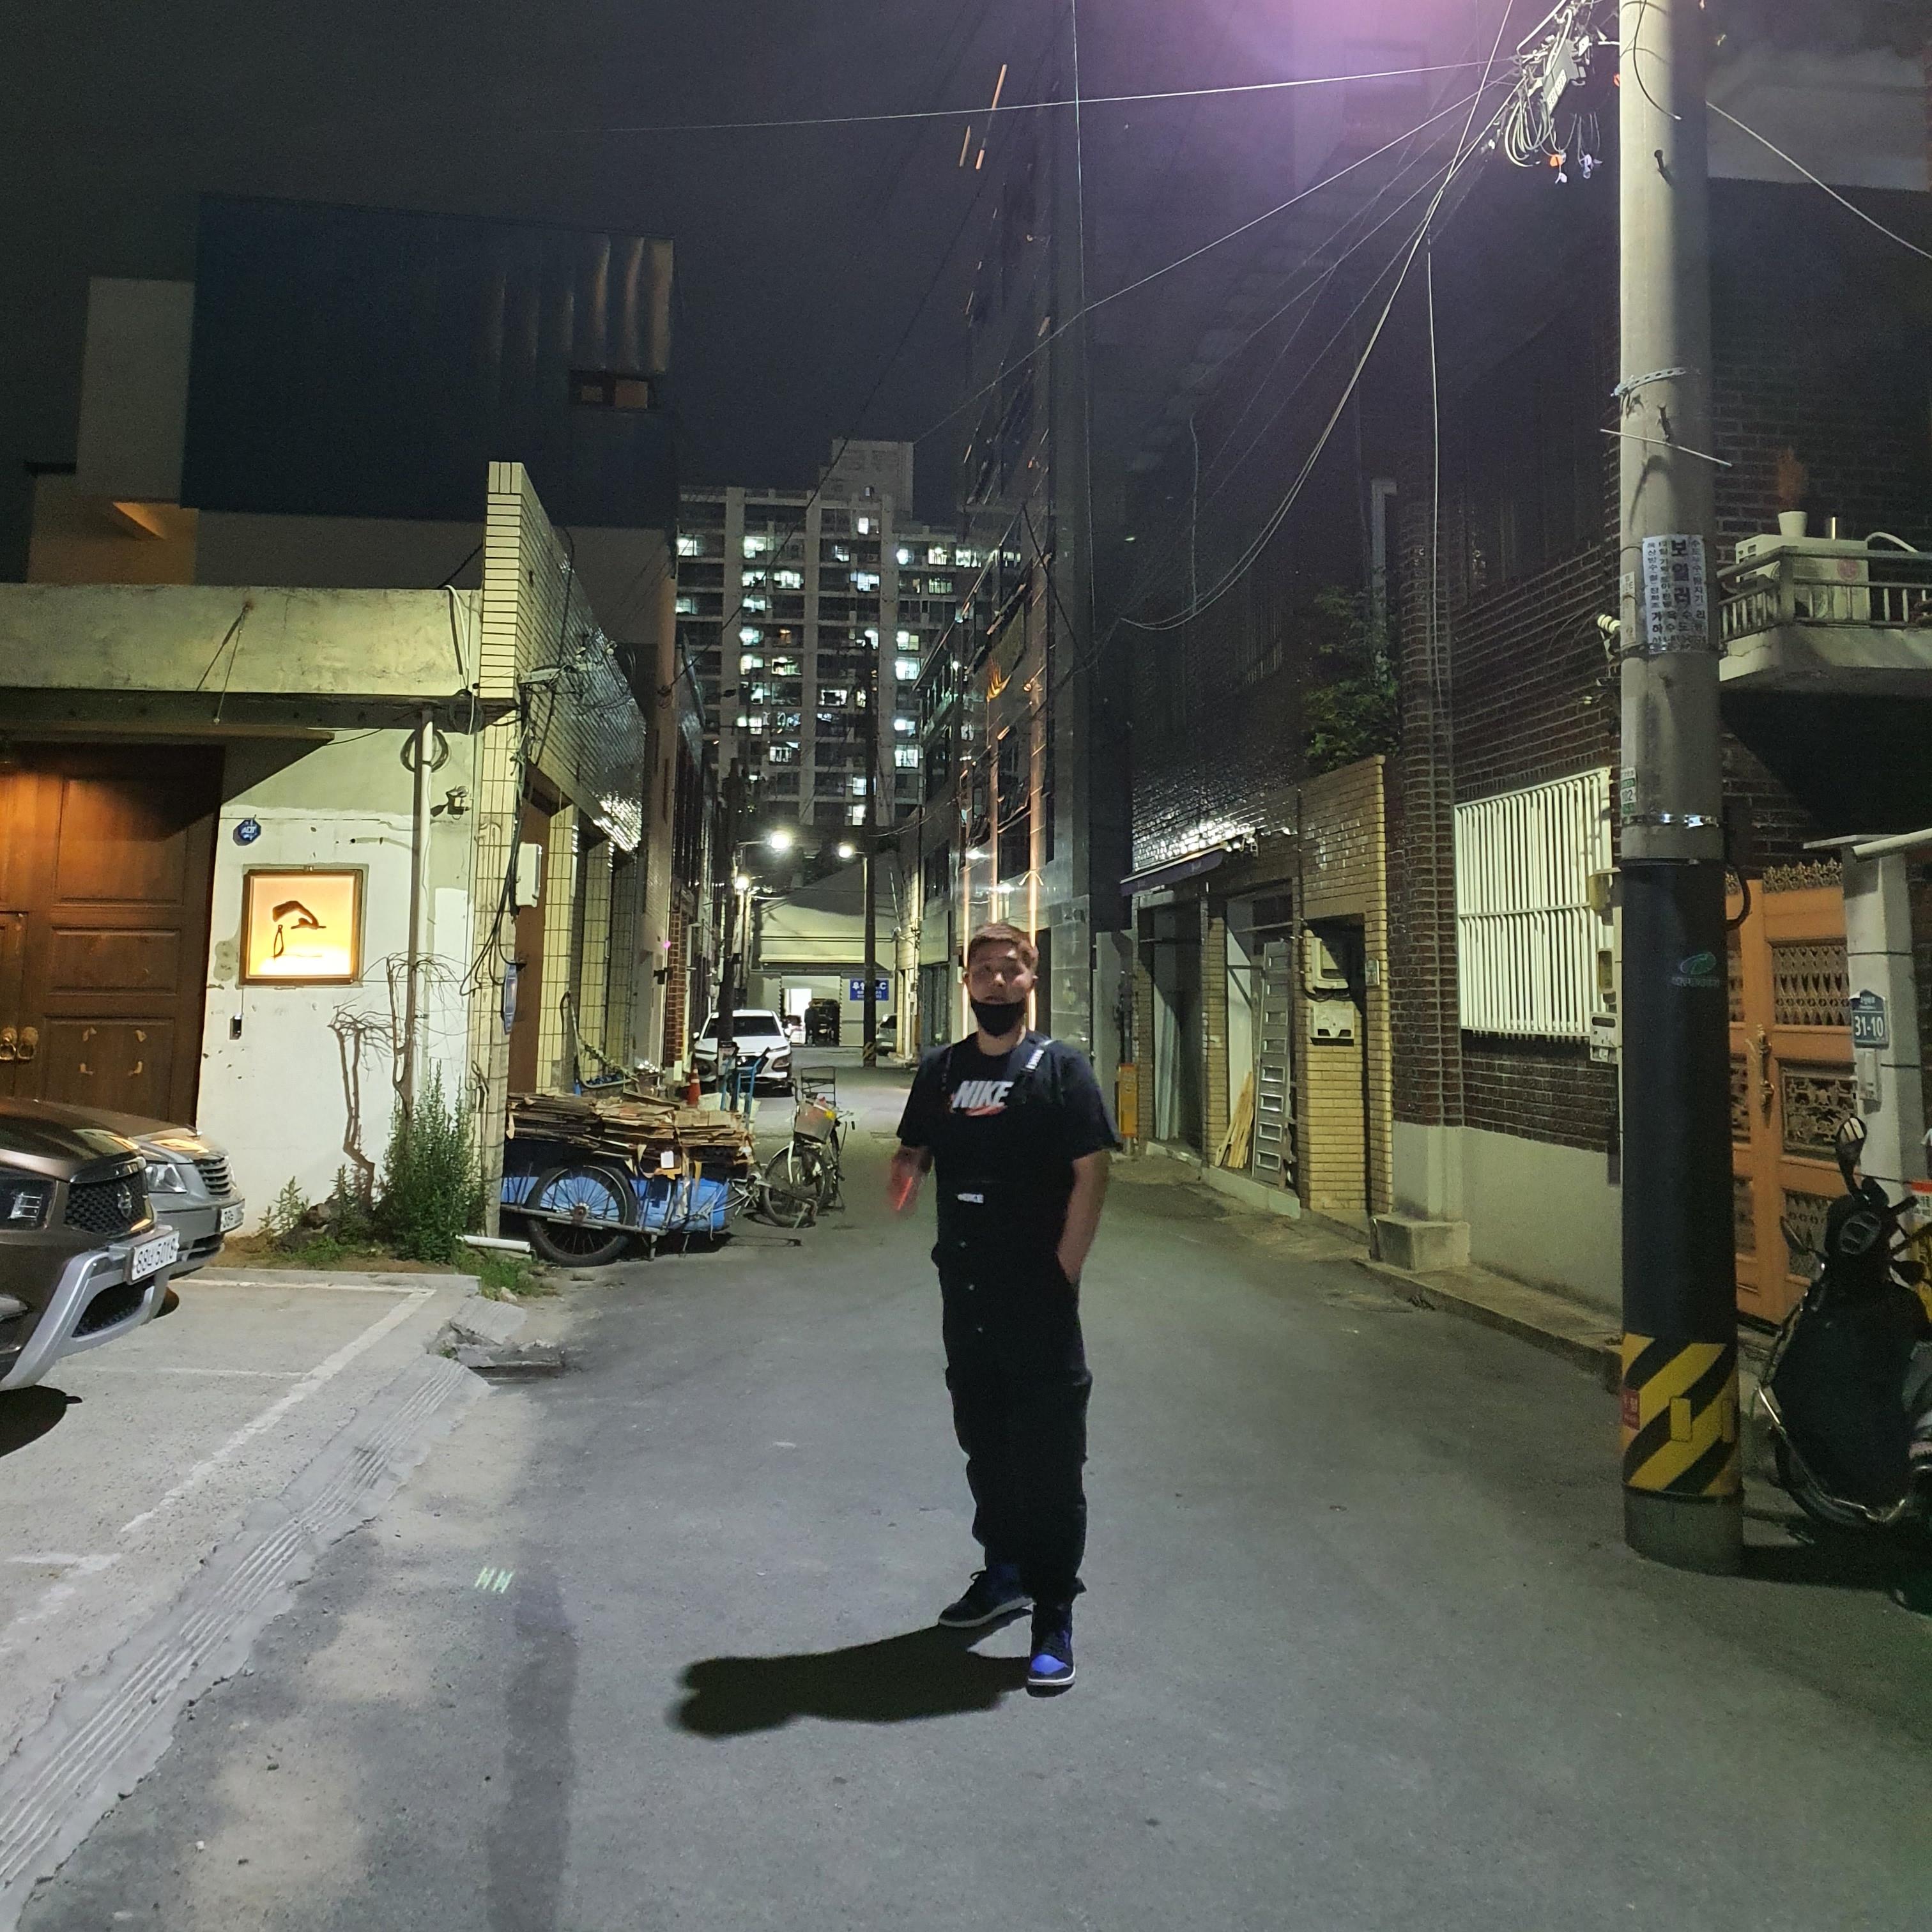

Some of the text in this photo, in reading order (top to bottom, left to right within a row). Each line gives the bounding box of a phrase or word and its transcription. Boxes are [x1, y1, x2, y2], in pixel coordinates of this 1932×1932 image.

[241, 825, 257, 834] ADT
[1855, 1015, 1883, 1037] 31-10
[952, 1080, 1015, 1108] NIKE
